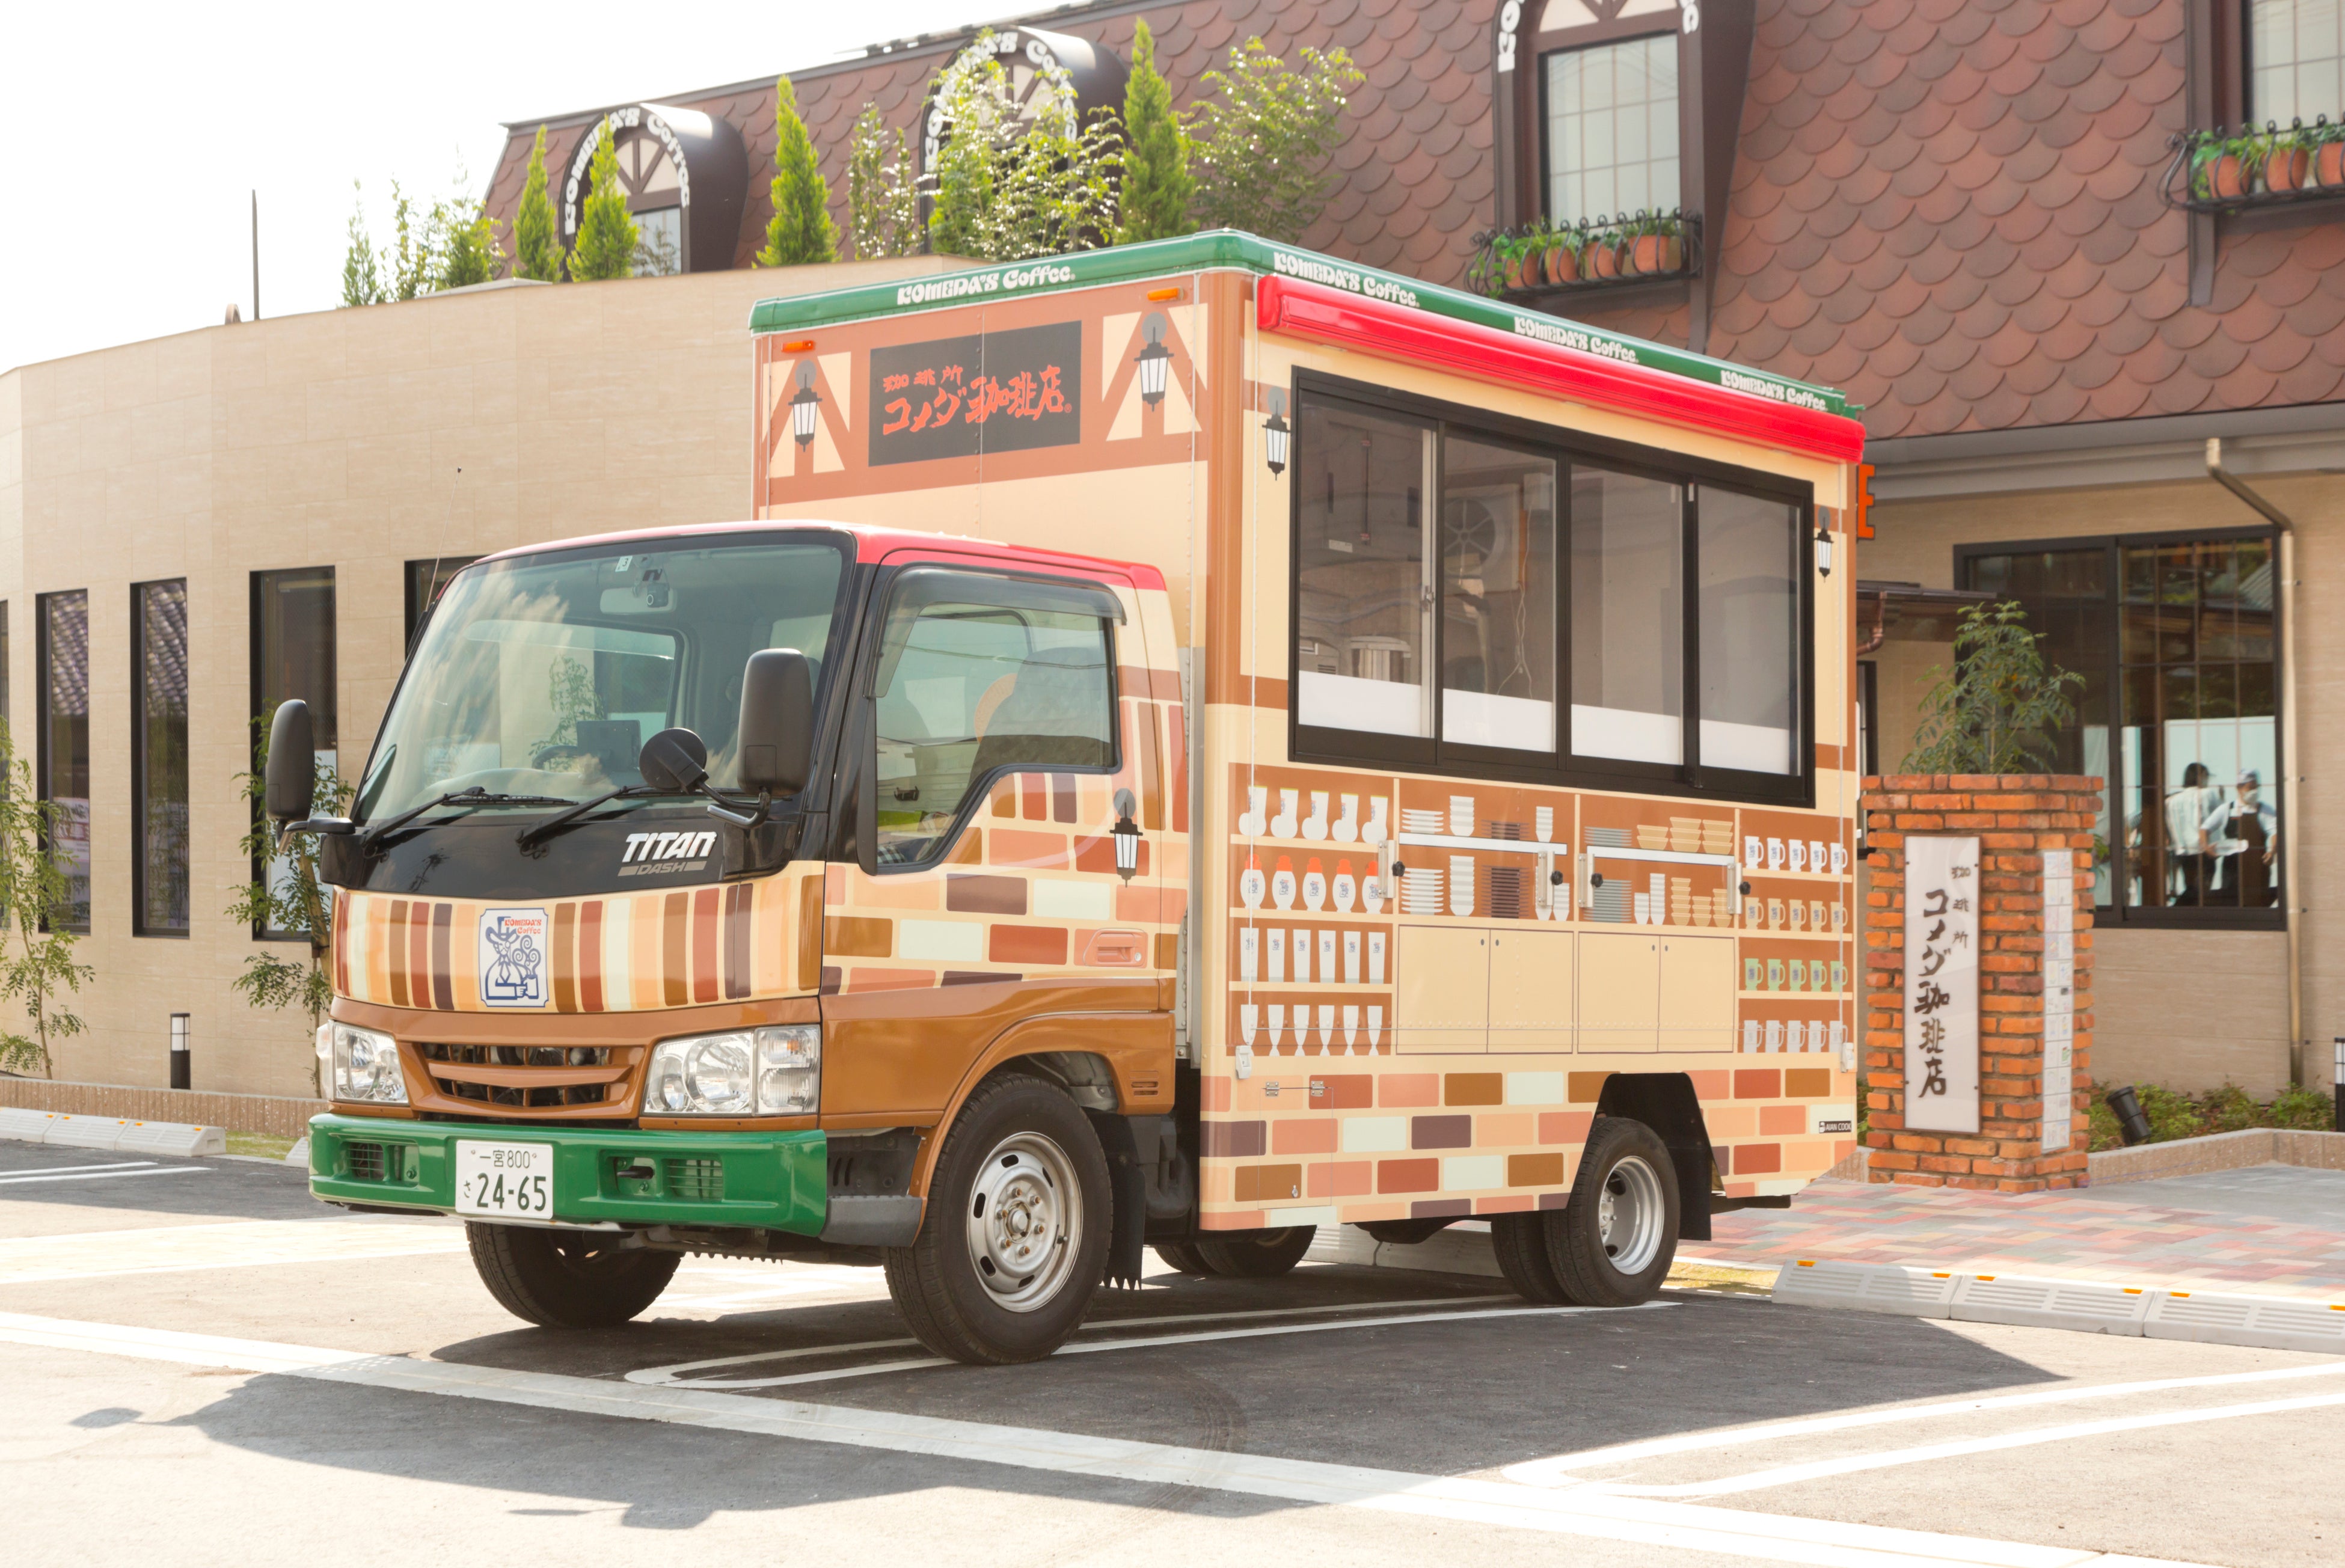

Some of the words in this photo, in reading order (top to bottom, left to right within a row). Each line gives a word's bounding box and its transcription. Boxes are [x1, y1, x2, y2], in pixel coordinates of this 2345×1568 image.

[897, 272, 999, 305] KOMEDA'S
[1002, 265, 1071, 290] Coffee
[1274, 252, 1361, 292] KOMEDA'S
[1363, 277, 1417, 307] Coffee
[1514, 316, 1589, 351] KOMEDA'S
[1590, 337, 1637, 363] Coffee
[883, 364, 1065, 435] コメダ珈琲店
[1786, 388, 1827, 412] Coffee
[622, 831, 717, 862] TITAN
[636, 862, 686, 875] DASH
[1914, 889, 1951, 1098] コメダ珈琲店
[477, 1173, 546, 1211] 24-65
